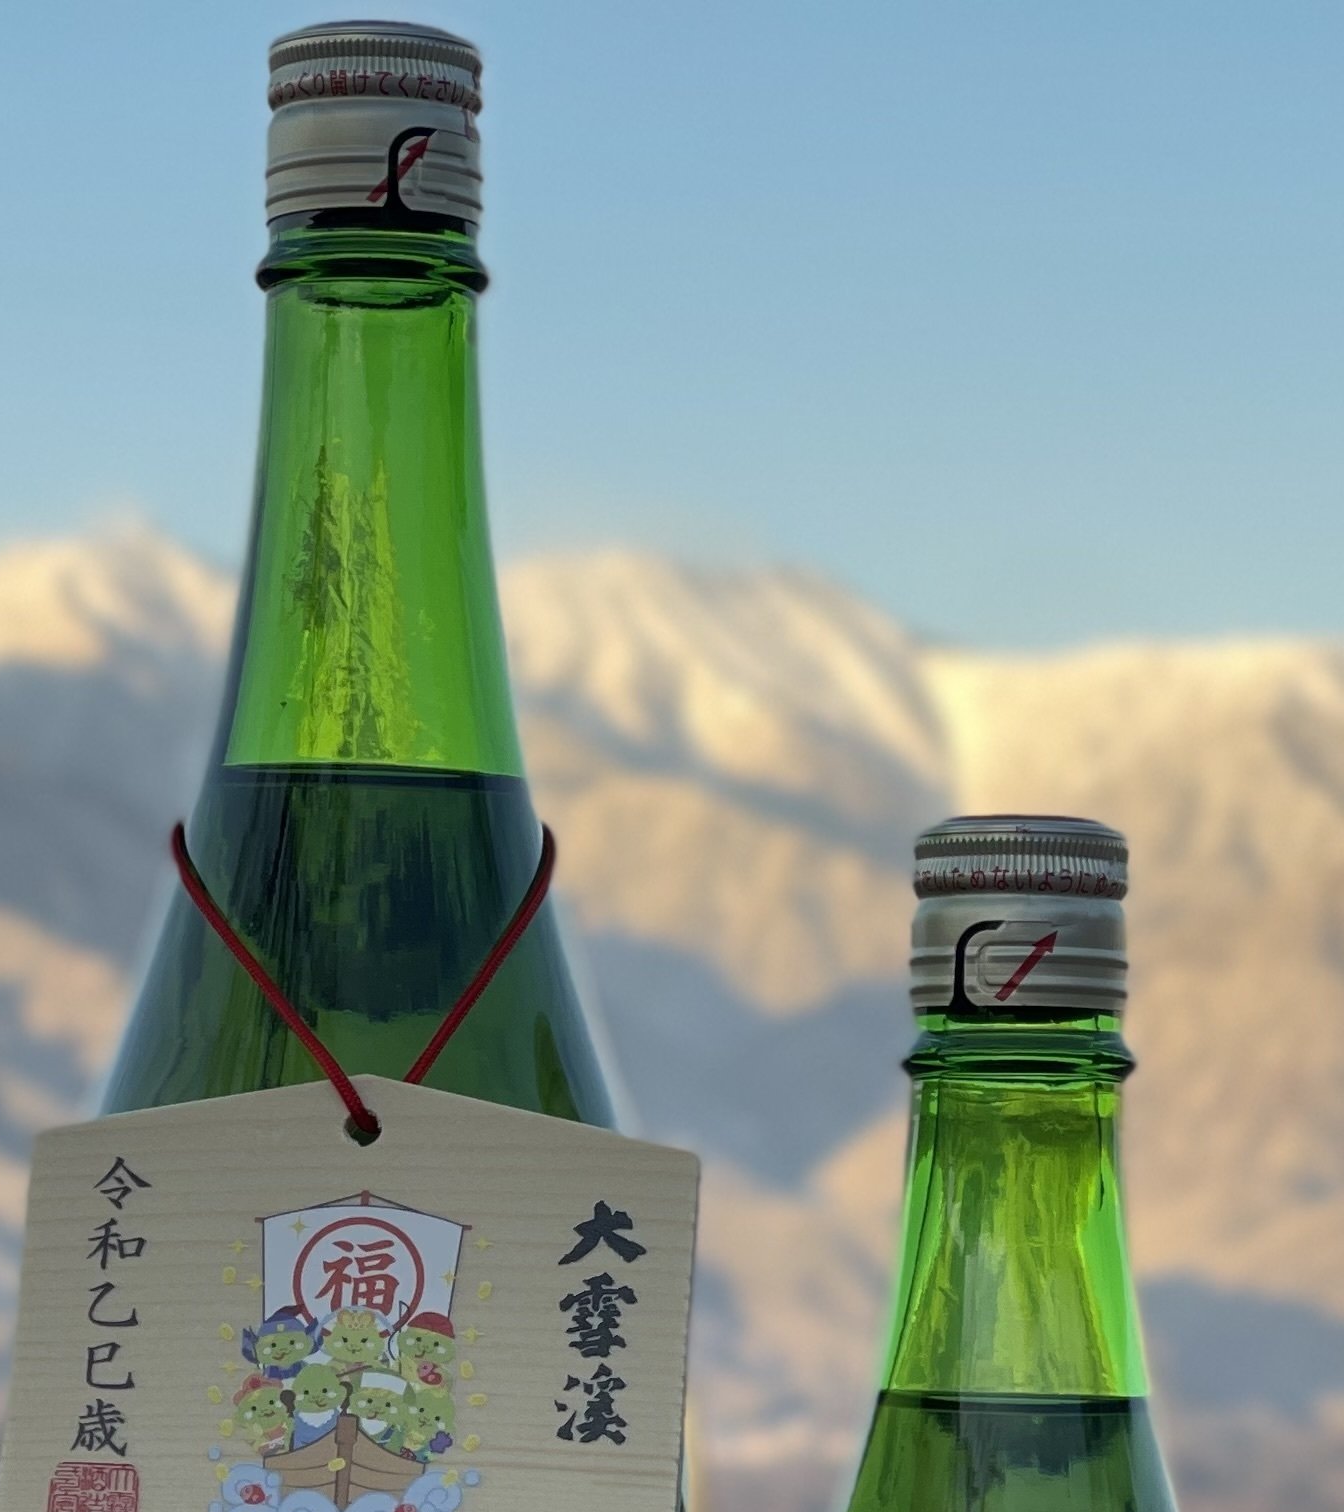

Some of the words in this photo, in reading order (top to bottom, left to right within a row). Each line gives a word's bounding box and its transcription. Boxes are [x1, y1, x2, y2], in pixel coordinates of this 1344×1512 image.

[69, 1156, 153, 1457] 令和乙巳歳
[314, 1239, 399, 1312] 福
[554, 1200, 648, 1446] 大雪渓
